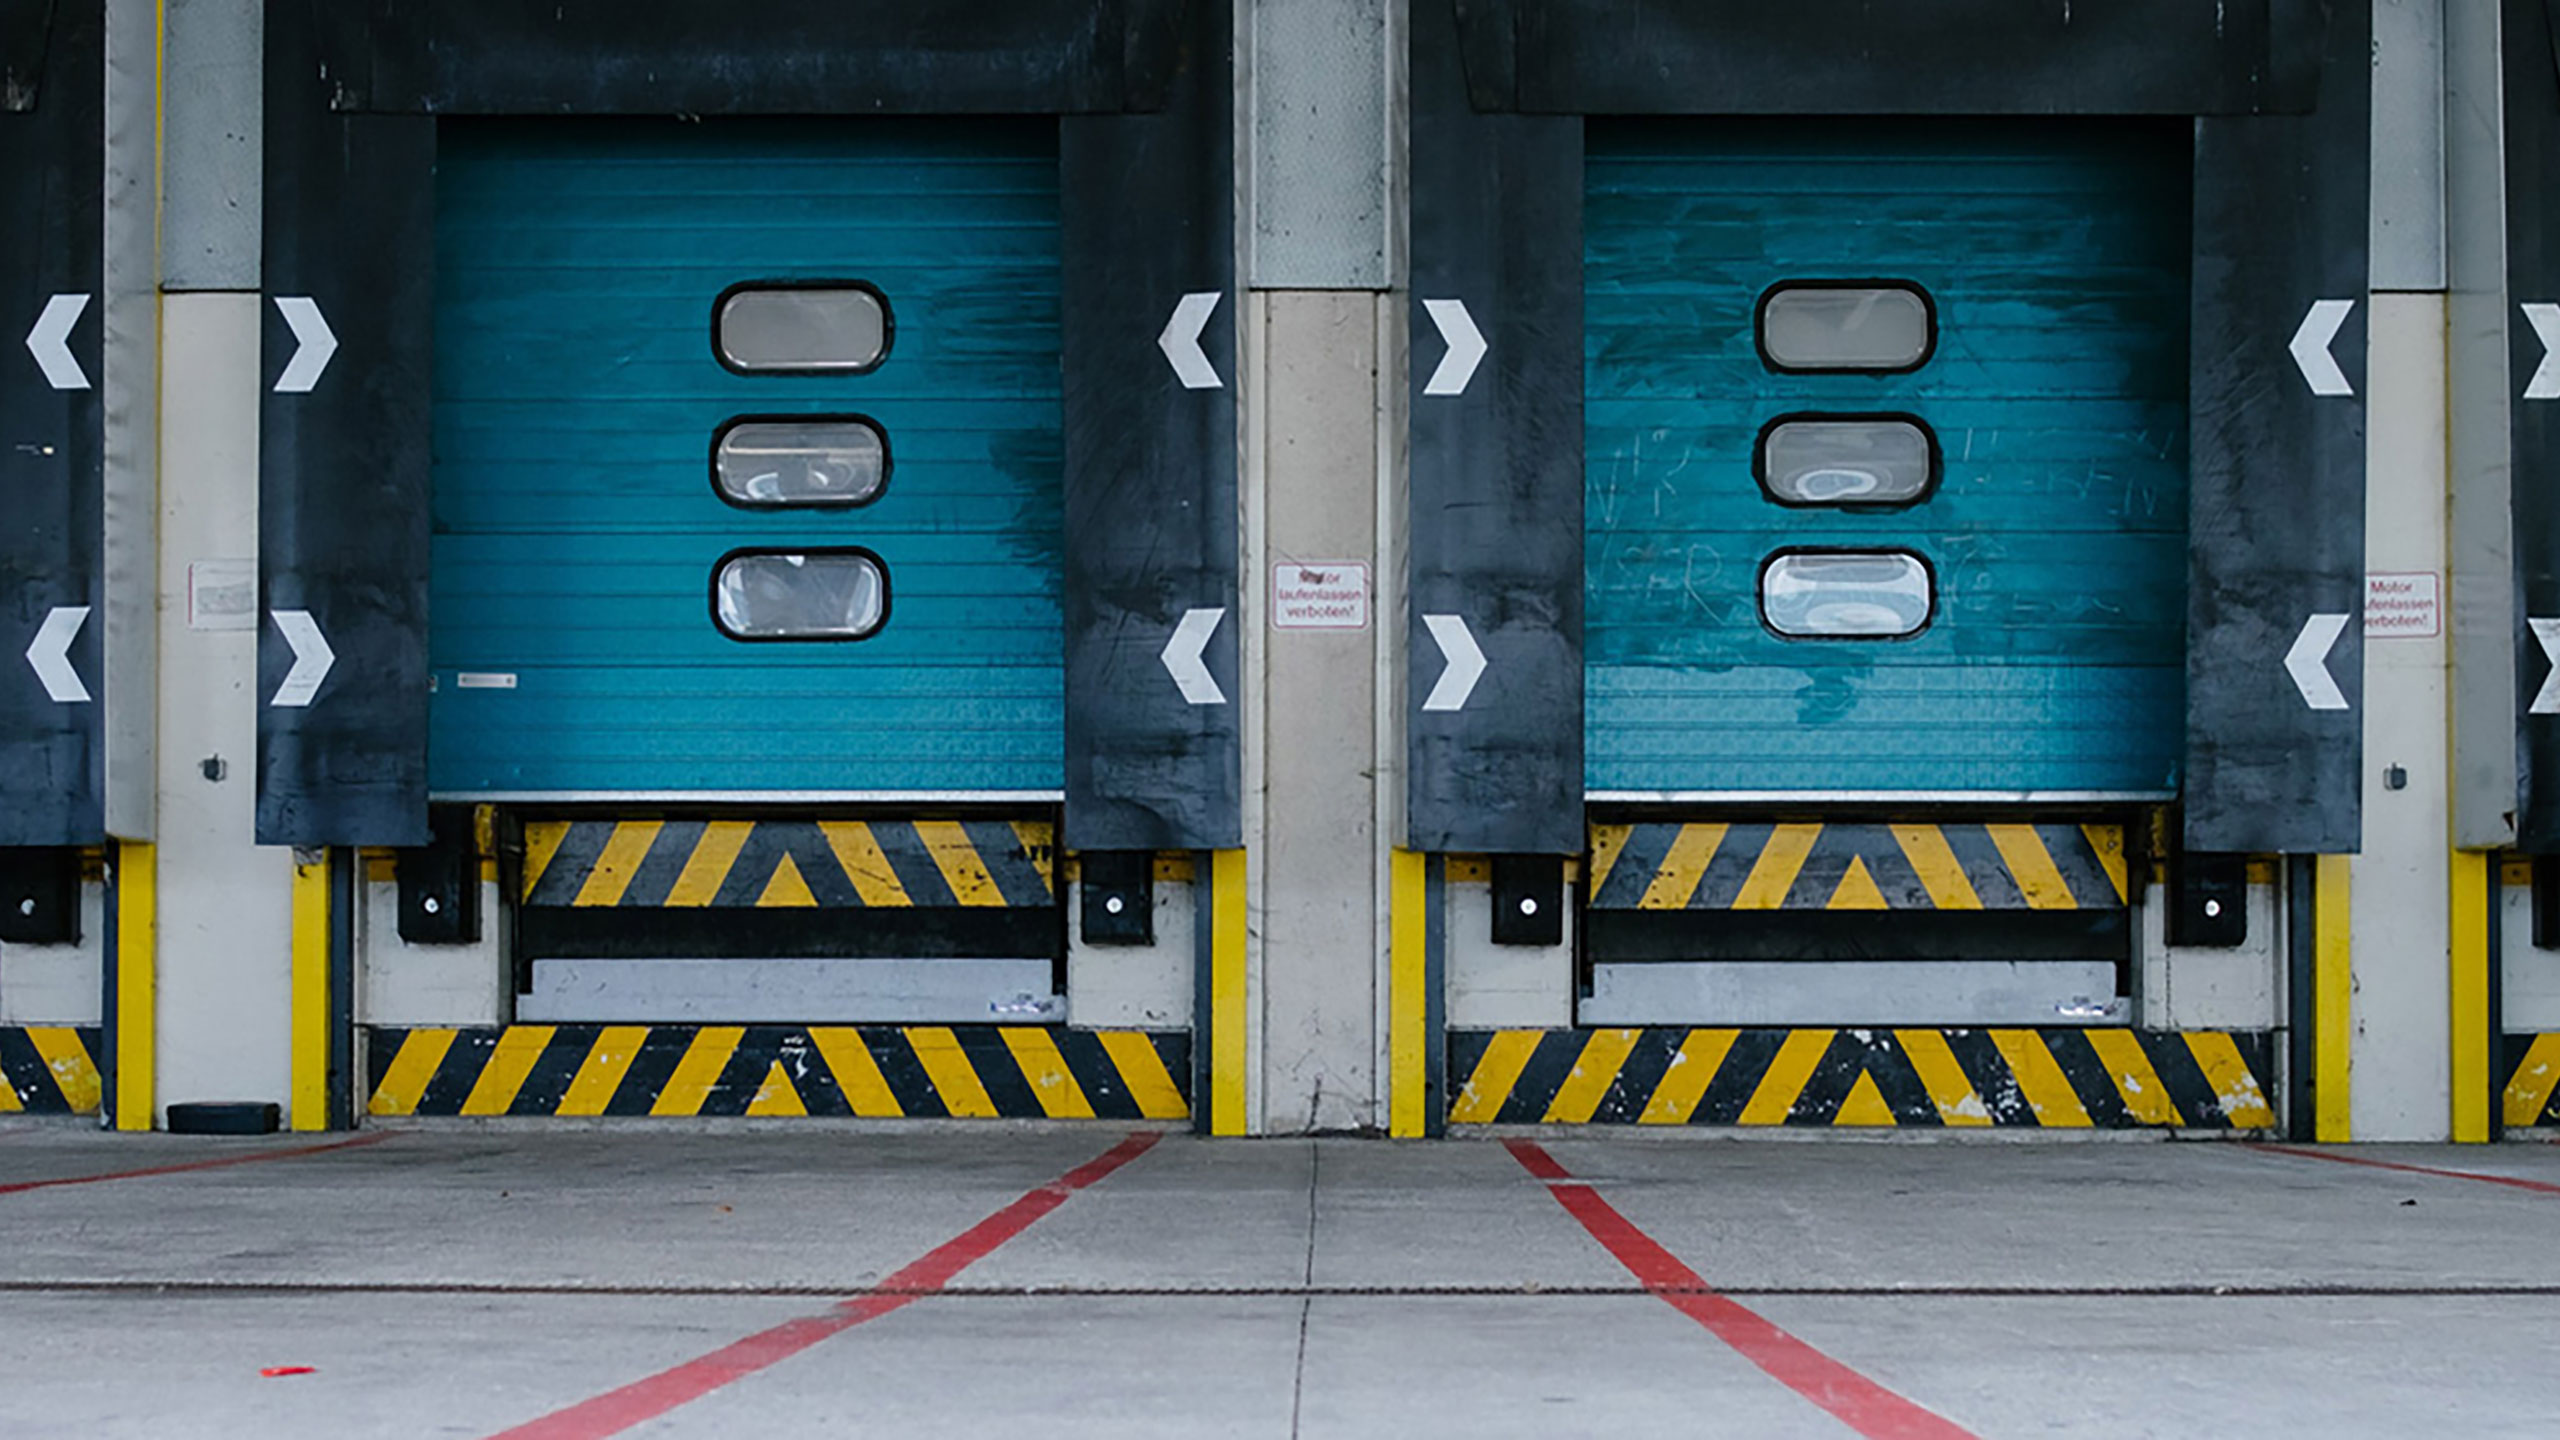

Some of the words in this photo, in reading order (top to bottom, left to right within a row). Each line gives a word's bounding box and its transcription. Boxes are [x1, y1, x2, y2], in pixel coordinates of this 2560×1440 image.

[2370, 581, 2412, 593] Motor
[1278, 588, 1361, 601] laufenlassen
[1286, 604, 1355, 618] verboten!
